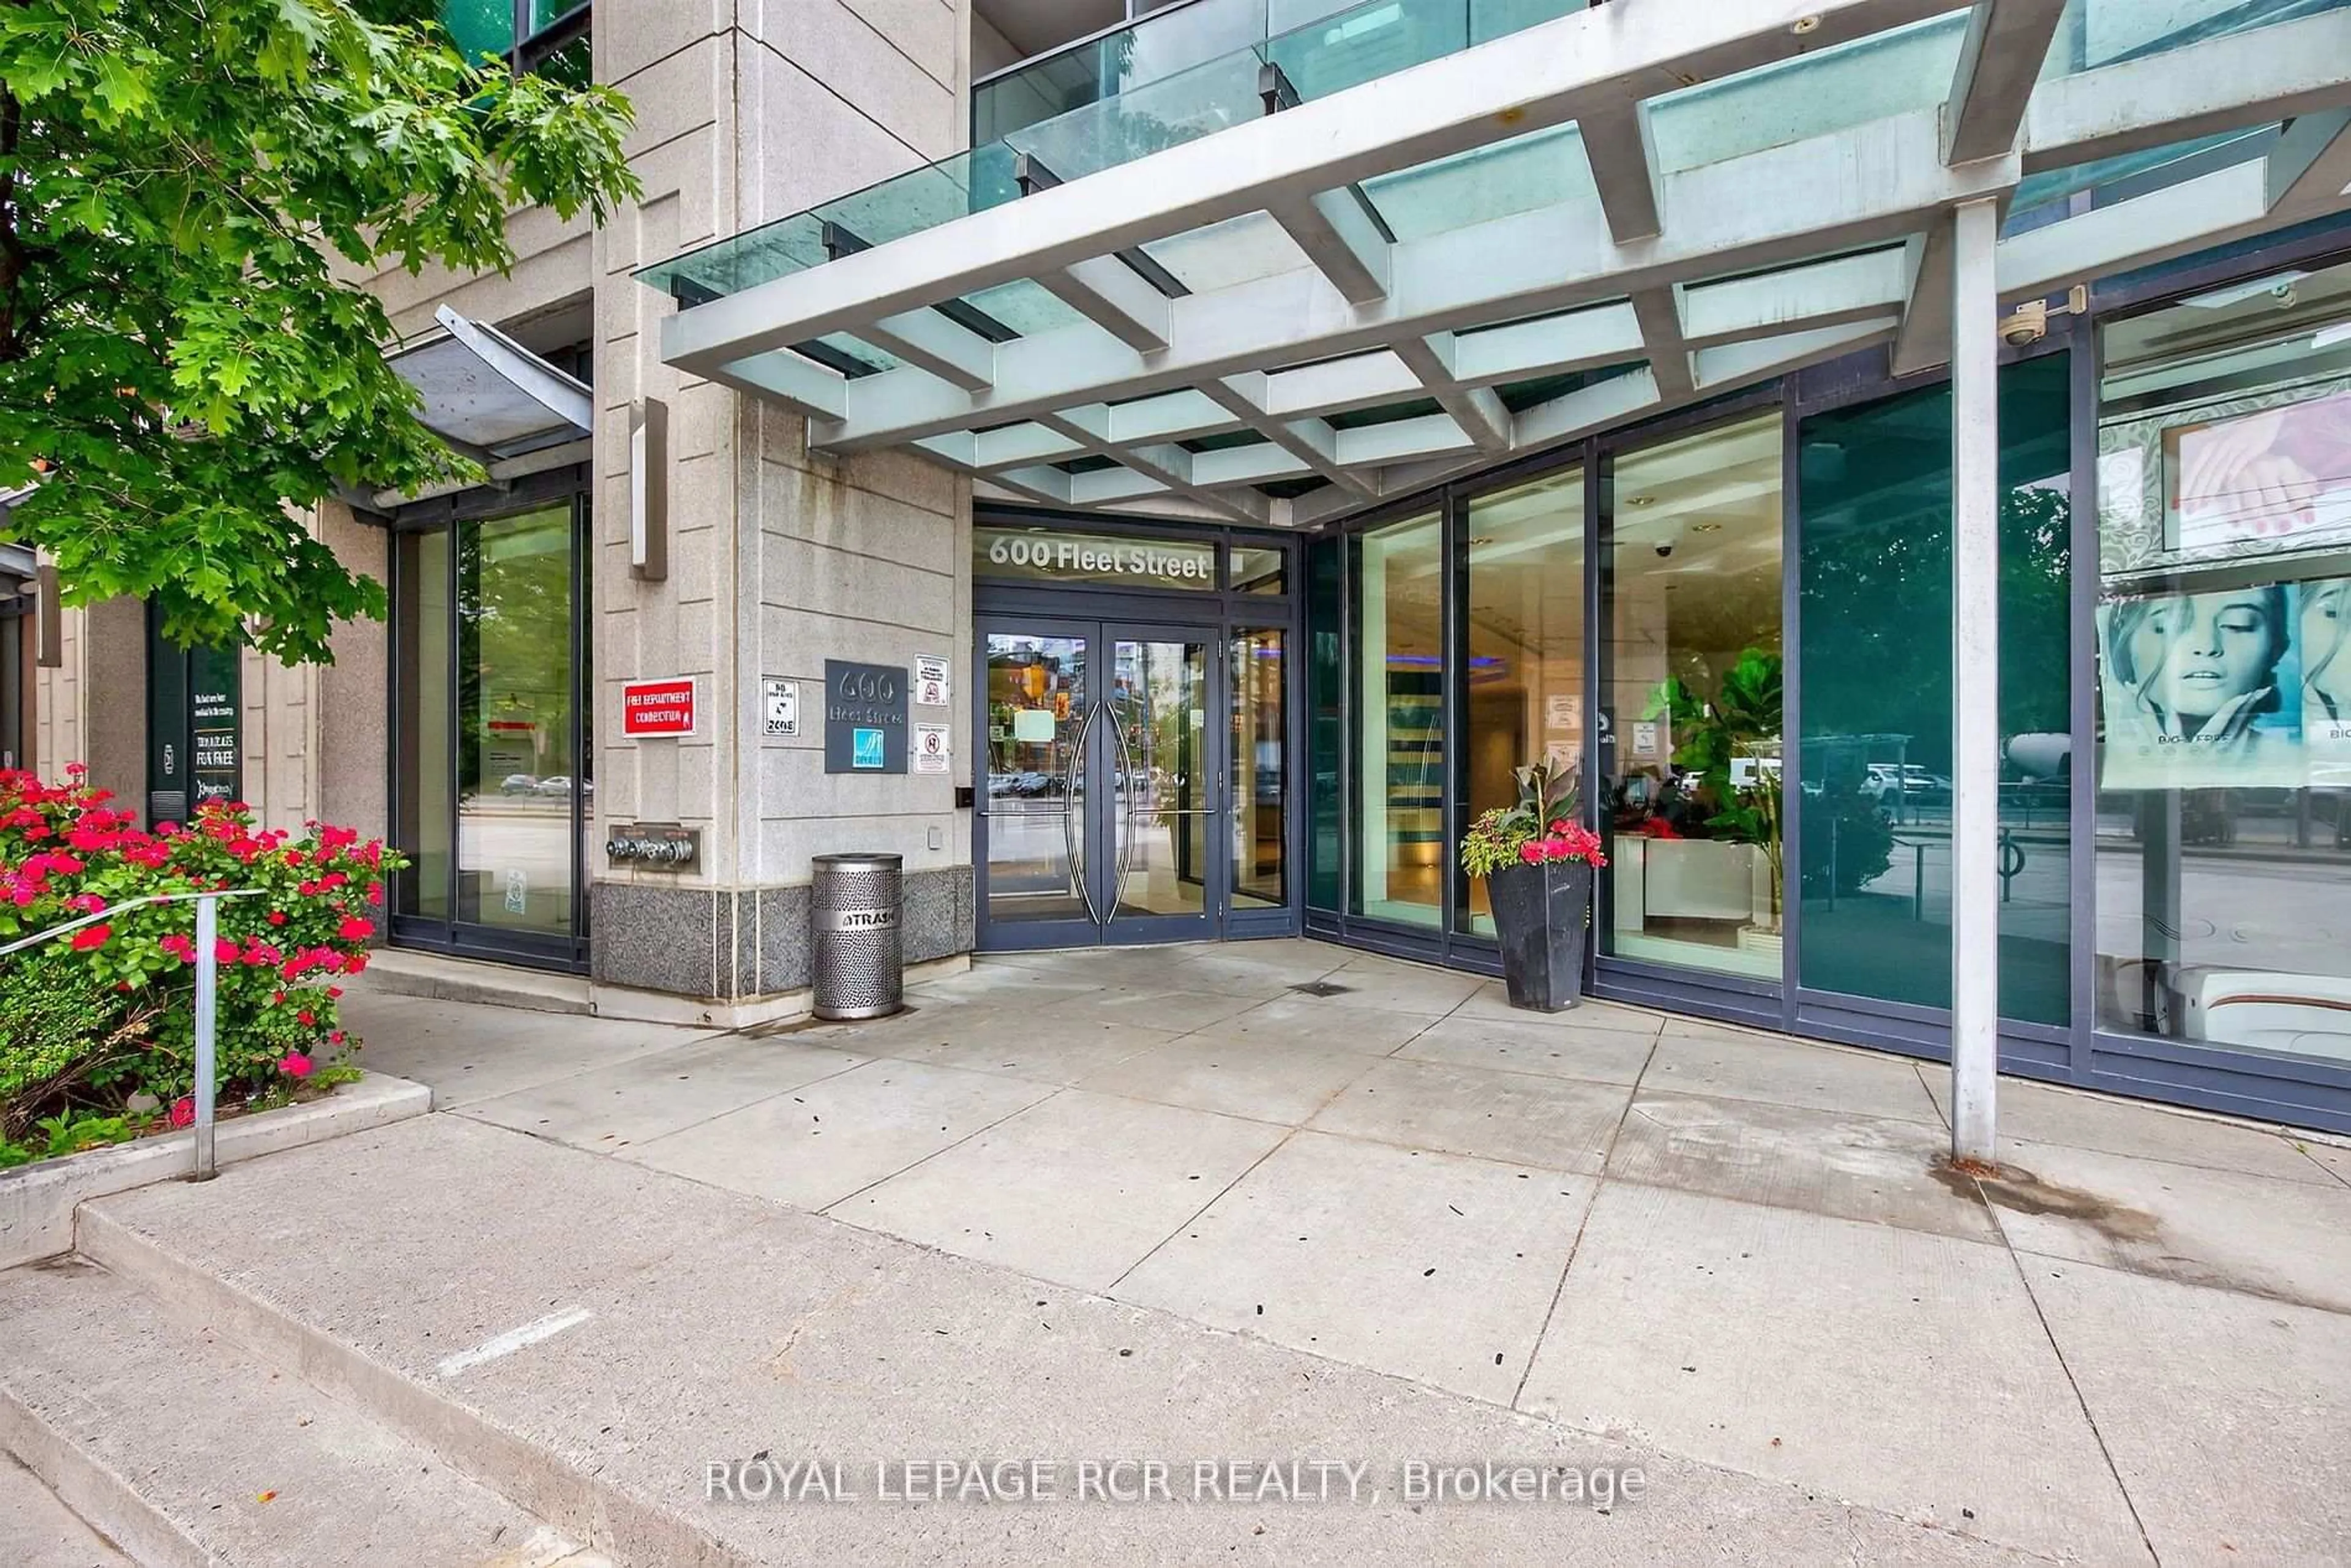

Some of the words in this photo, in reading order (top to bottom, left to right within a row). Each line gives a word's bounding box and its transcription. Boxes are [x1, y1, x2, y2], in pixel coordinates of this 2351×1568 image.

[989, 536, 1051, 567] 600
[1057, 542, 1123, 572] Fleet
[1129, 547, 1207, 579] Street
